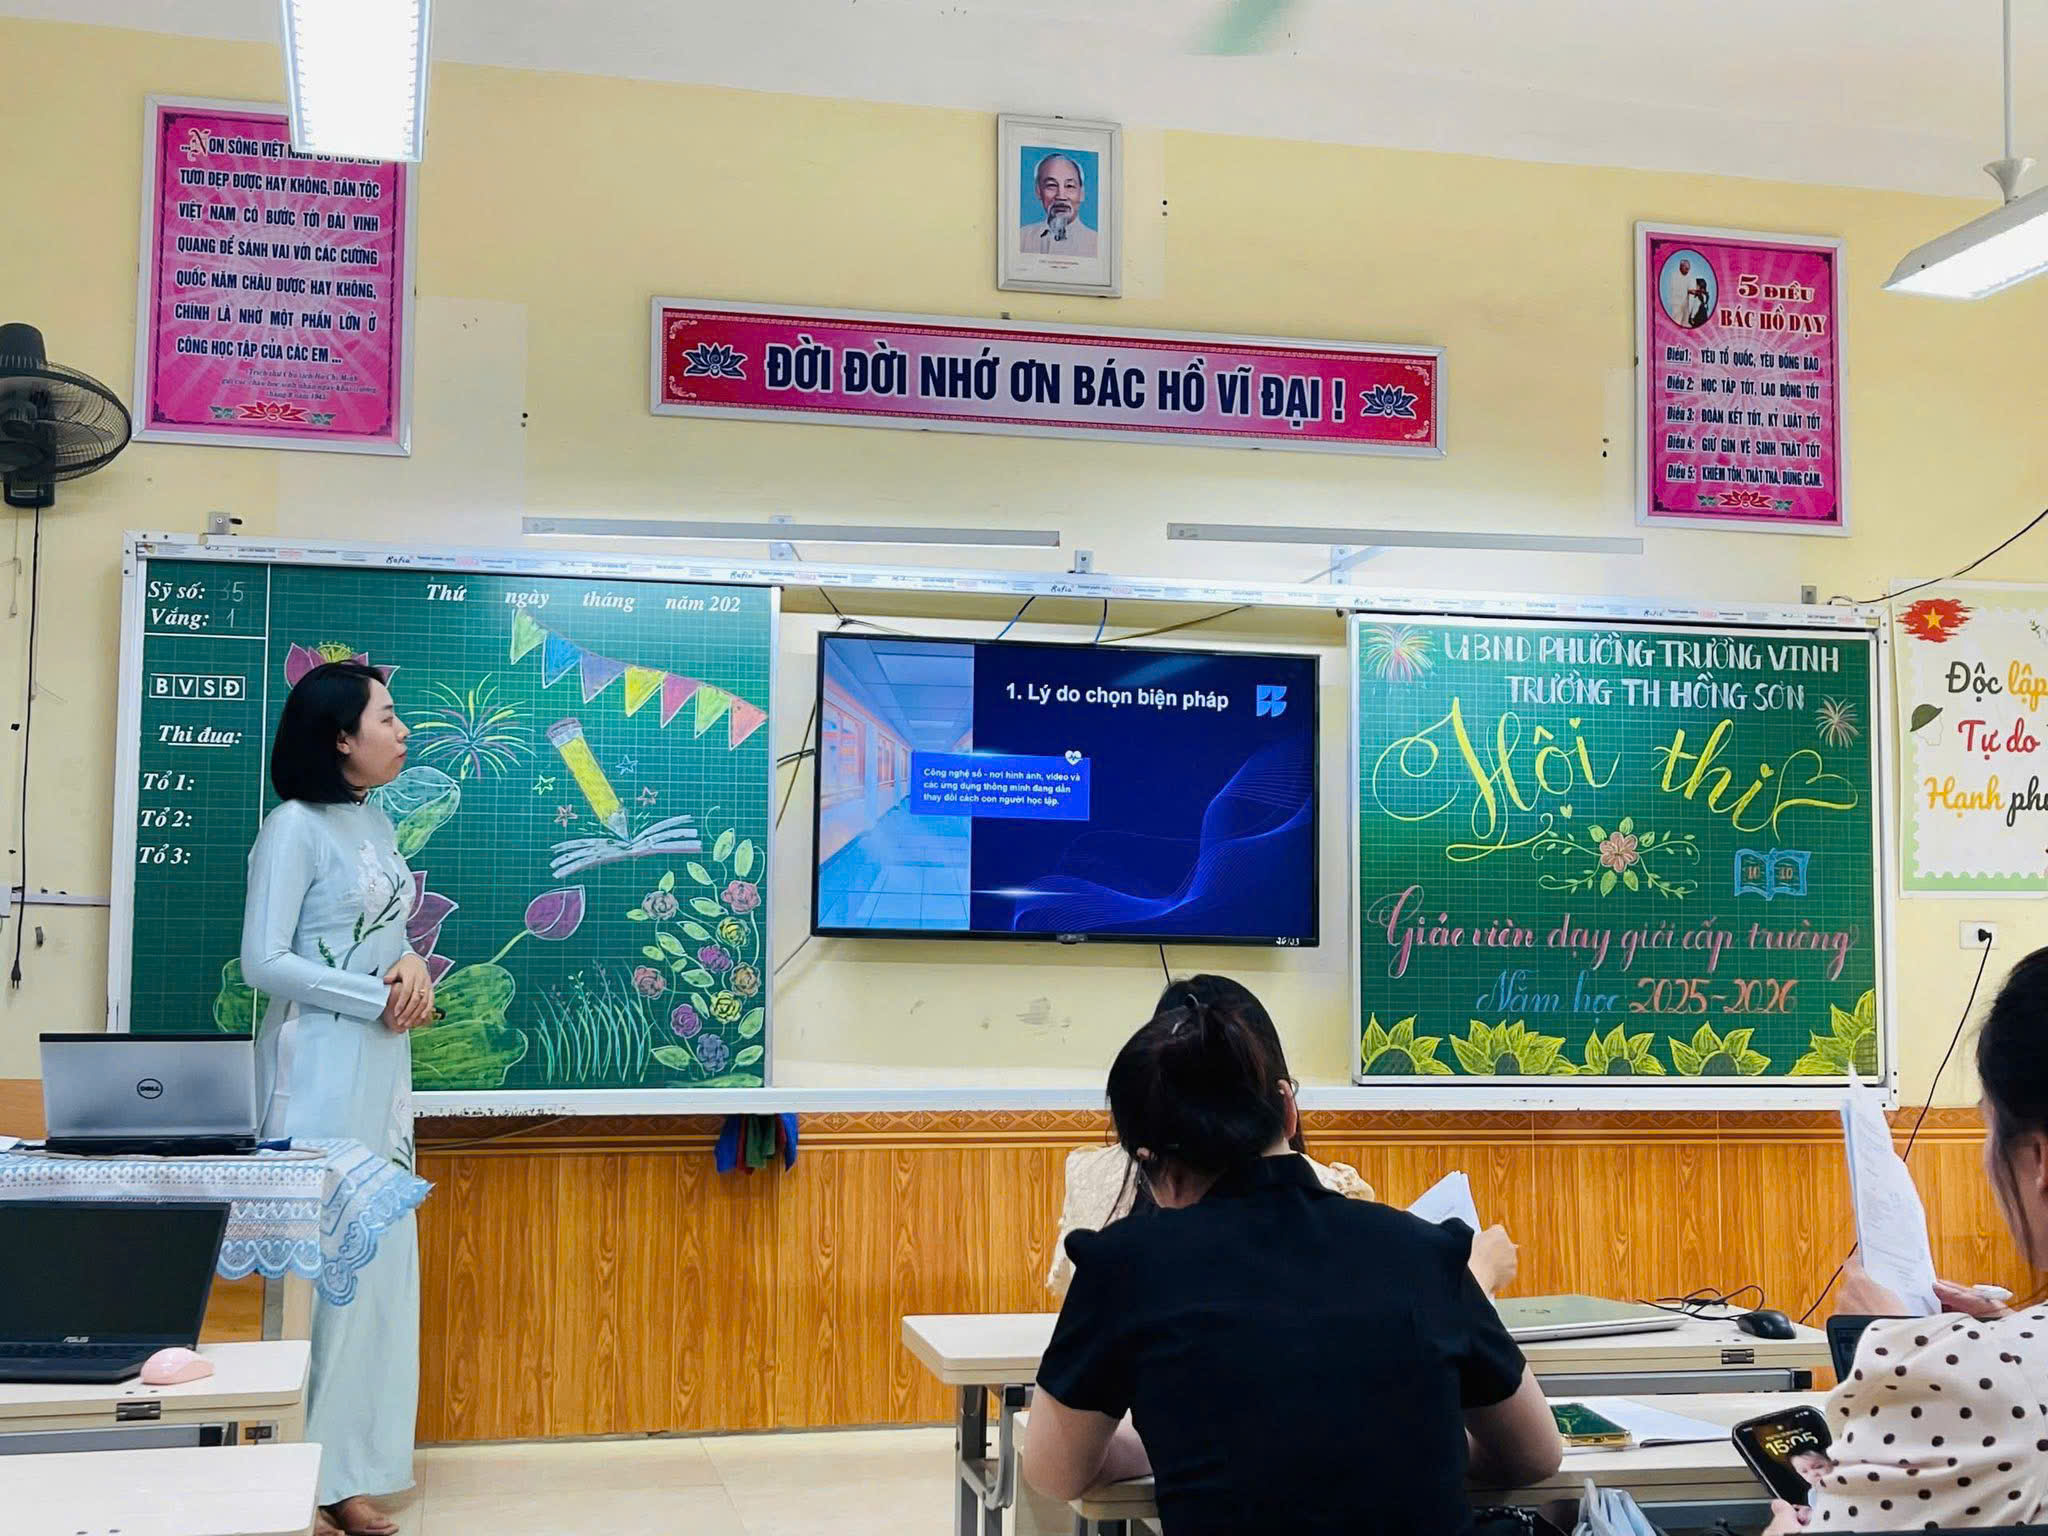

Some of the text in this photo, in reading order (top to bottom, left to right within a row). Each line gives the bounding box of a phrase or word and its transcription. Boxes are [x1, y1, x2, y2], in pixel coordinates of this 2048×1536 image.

[228, 137, 258, 156] SÔNG
[262, 141, 284, 161] VIỆT
[208, 171, 379, 201] ĐẸP ĐƯỢC HAY KHÔNG, DÂN TỘC
[179, 202, 378, 231] VIỆT NAM CÓ BƯỚC TỚI ĐÀI VINH
[178, 234, 377, 264] QUANG ĐỂ SÁNH VAI VỚI CÁC CƯỜNG
[177, 266, 376, 299] QUỐC NĂM CHÂU ĐƯỢC HAY KHÔNG,
[1739, 276, 1758, 296] 5
[176, 303, 376, 332] CHÍNH LÀ NHỜ MỘT LỚN Ở
[1721, 306, 1825, 337] BÁC HỒ DẠY
[178, 338, 328, 363] CÔNG HỌC TẬP CỦA CÁC EM
[766, 337, 1343, 426] ĐỜI ĐỜI NHỚ ƠN BÁC HỒ VĨ ĐẠI !
[1701, 379, 1717, 394] HỌC
[1762, 383, 1775, 396] LAO
[1756, 441, 1776, 455] SINH
[148, 581, 205, 601] Sỹ số:
[427, 583, 741, 612] Thứ ngày tháng năm 202
[151, 607, 209, 630] Vắng:
[226, 608, 234, 628] 1
[1445, 631, 1839, 672] UBND PHƯỜNG TRƯỜNG VINH
[1006, 683, 1229, 712] 1. Lý do chọn biện pháp
[1504, 669, 1805, 711] TRƯỜNG TH HỒNG SƠN
[1945, 660, 2048, 712] Độc lập
[159, 725, 242, 744] Thi đua:
[1957, 717, 2041, 761] Tự do
[143, 770, 194, 791] Tổ 1:
[924, 768, 1080, 781] Công nghệ số nơi hình video và
[960, 782, 981, 792] dụng
[983, 783, 1007, 793] thông
[1010, 784, 1031, 792] minh
[1032, 784, 1054, 794] đang
[924, 793, 941, 802] thay
[959, 794, 979, 802] cách
[1027, 797, 1042, 806] học
[1924, 774, 2005, 819] Hạnh
[141, 807, 192, 827] Tổ 2:
[139, 844, 191, 864] Tổ 3:
[1367, 884, 1465, 979] Giáo
[1548, 913, 1610, 971] dạy
[1682, 916, 1733, 973] cấp
[1476, 968, 1798, 1024] Năm học 2025-2026
[1765, 1432, 1818, 1455] 15:05
